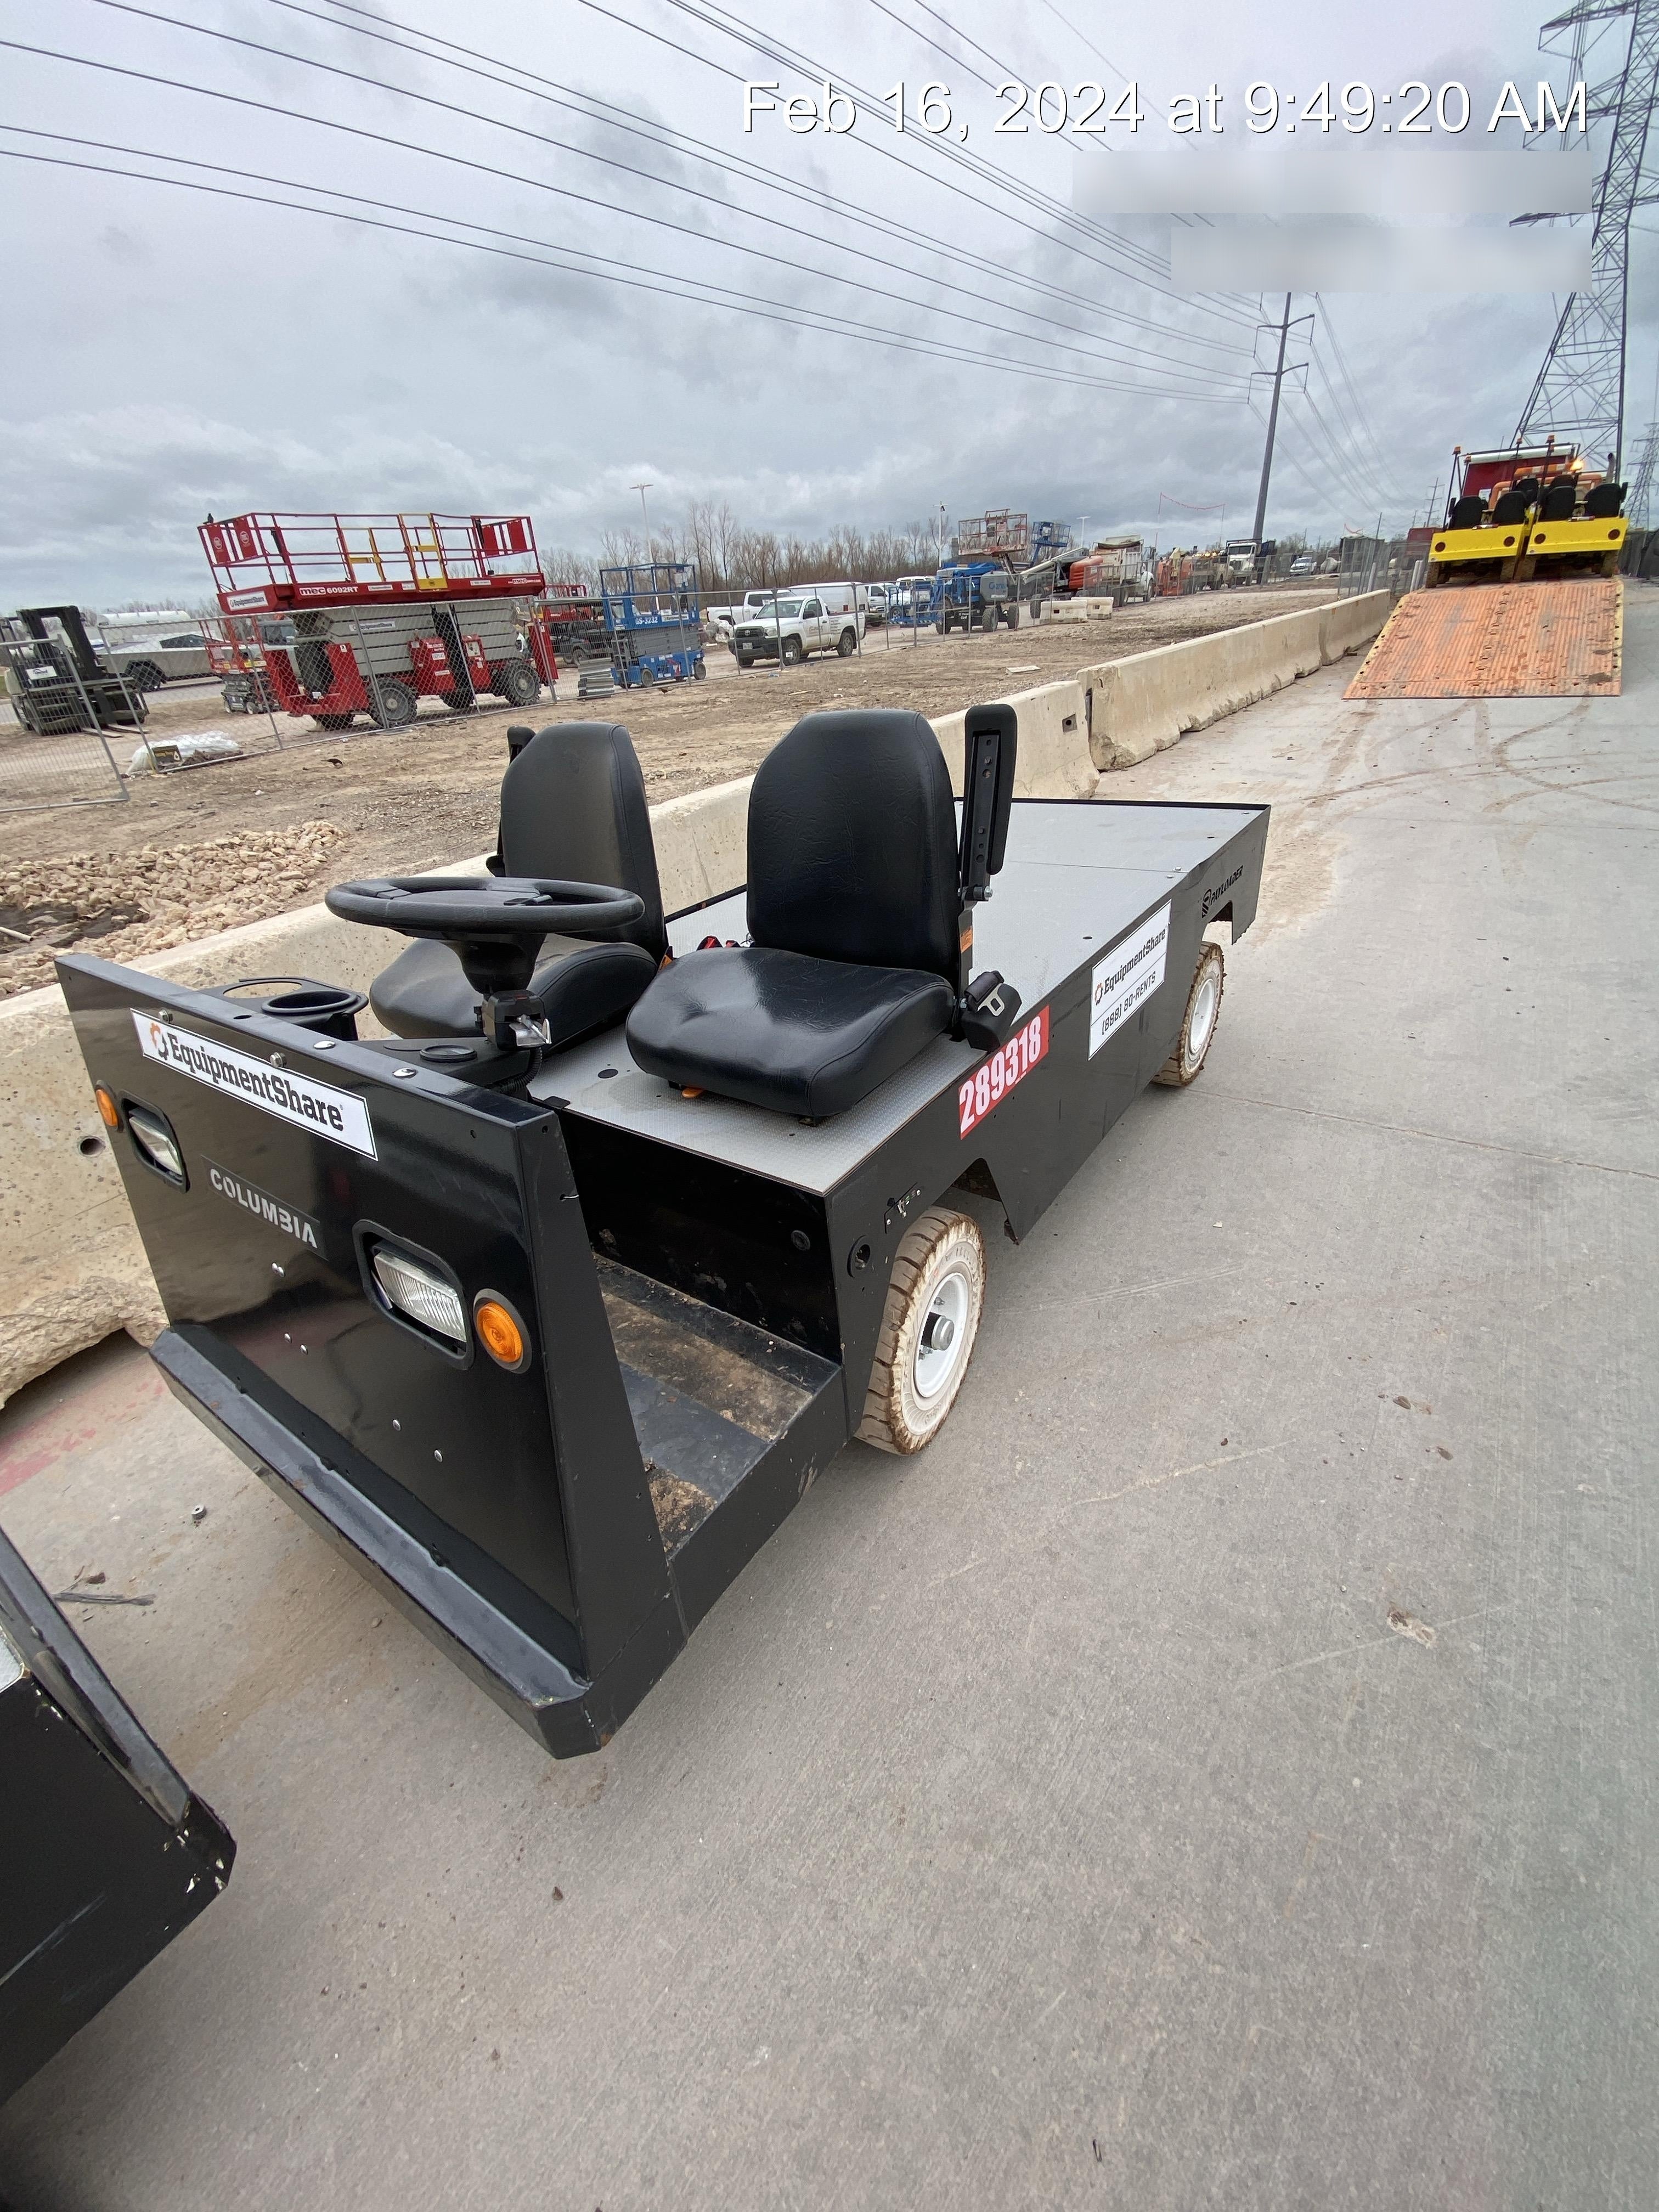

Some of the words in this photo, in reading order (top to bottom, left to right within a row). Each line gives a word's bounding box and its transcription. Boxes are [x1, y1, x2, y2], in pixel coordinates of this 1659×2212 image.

[635, 616, 658, 625] GS-3232
[1103, 929, 1166, 995] EquipmentShare
[1102, 1003, 1122, 1036] (888)
[1124, 970, 1156, 1012] 80-RENTS
[167, 1032, 344, 1132] EquipmentShare
[959, 1015, 1041, 1135] 289318
[210, 1167, 318, 1249] COLUMBIA
